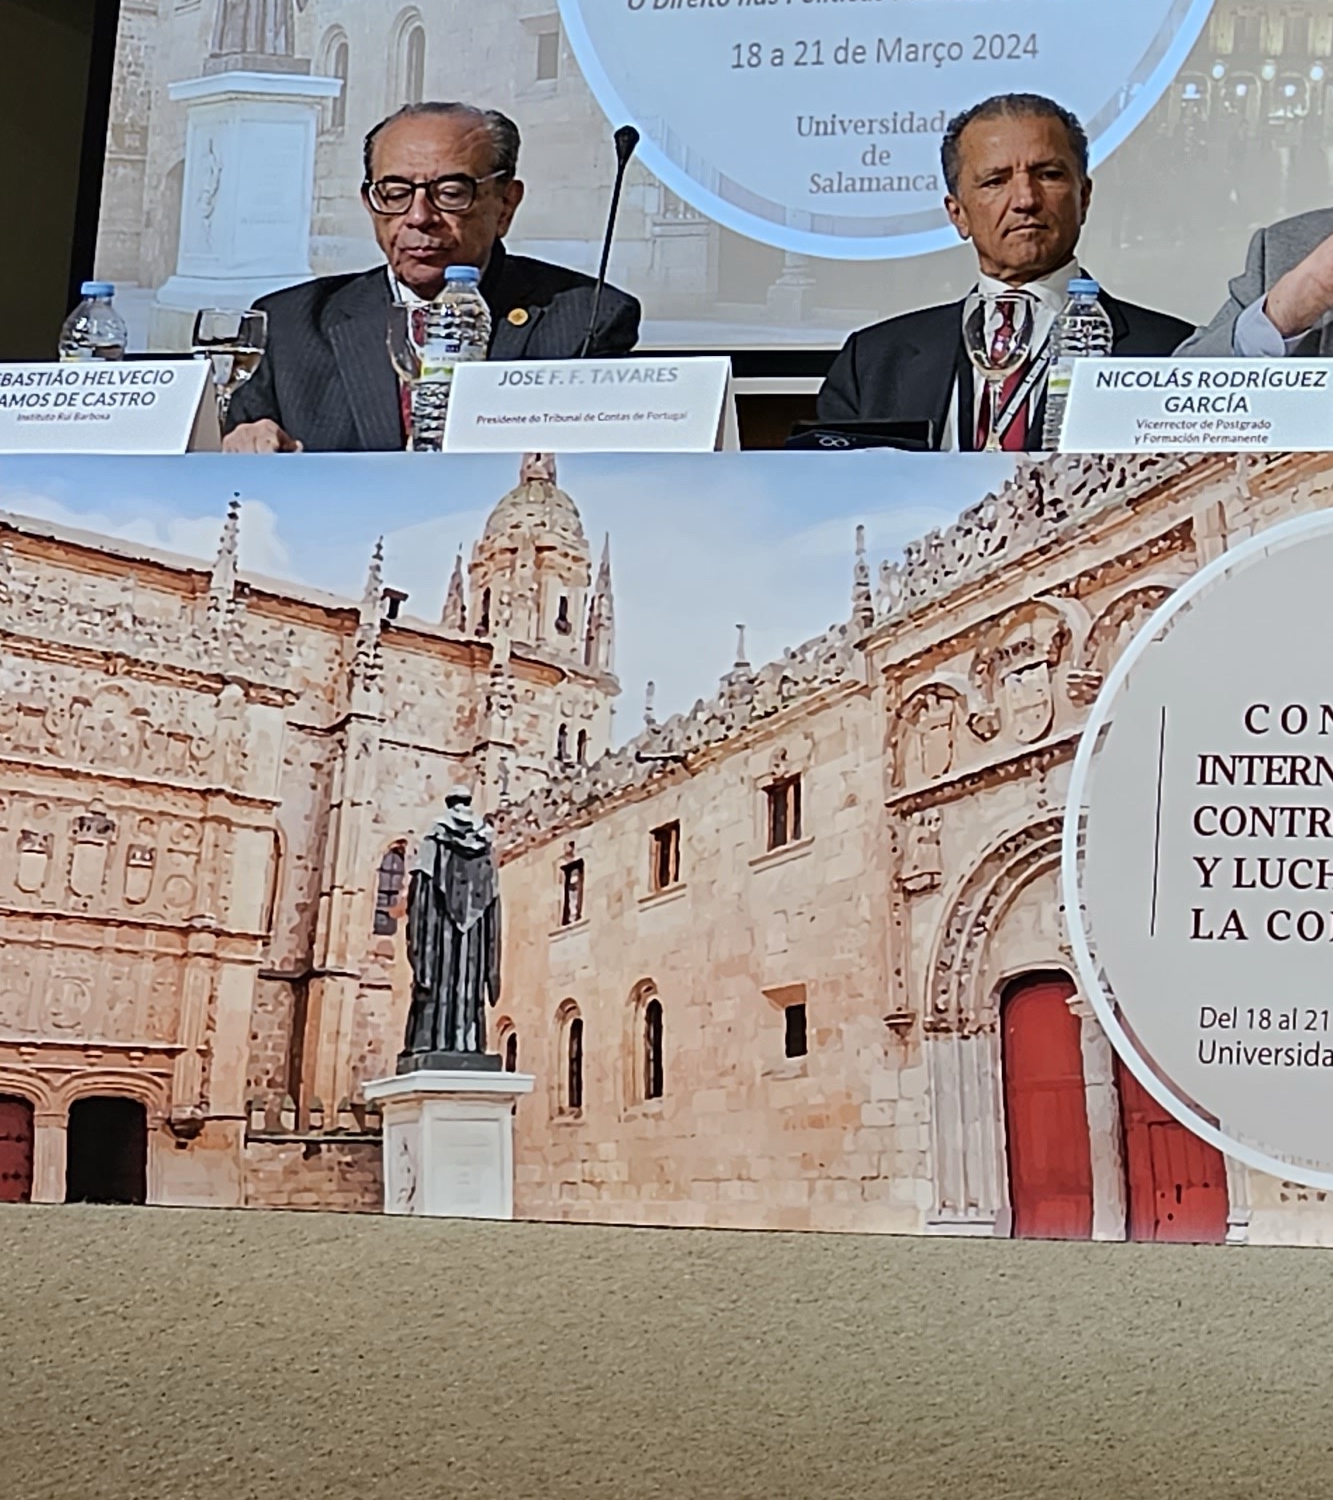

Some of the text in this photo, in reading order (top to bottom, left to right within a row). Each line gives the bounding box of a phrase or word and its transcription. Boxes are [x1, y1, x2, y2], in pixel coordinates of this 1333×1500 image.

[731, 33, 1039, 69] 18 a 21 de Março 2024
[797, 111, 949, 137] Universidad
[861, 144, 891, 166] de
[809, 171, 939, 194] Salamanca
[0, 368, 174, 387] BASTIÃO HELVECIO
[499, 367, 678, 386] JOSÉ F. F. TAVARES
[1096, 367, 1327, 389] NICOLÁS RODRÍGUEZ
[54, 393, 80, 407] DE
[82, 391, 156, 407] CASTRO
[1164, 393, 1248, 413] GARCÍA
[16, 412, 111, 422] Instituto Rui Barbosa
[477, 411, 688, 424] Presidente do Tribunal de Contas de Portugal
[1136, 419, 1272, 432] Vicerrector de Postgrado
[1134, 433, 1269, 445] y Formación Permanente
[1193, 858, 1222, 889] Y
[1190, 909, 1248, 941] LA
[1199, 1006, 1237, 1030] Del
[1246, 1008, 1272, 1031] 18
[1278, 1008, 1298, 1032] al
[1305, 1009, 1330, 1033] 21
